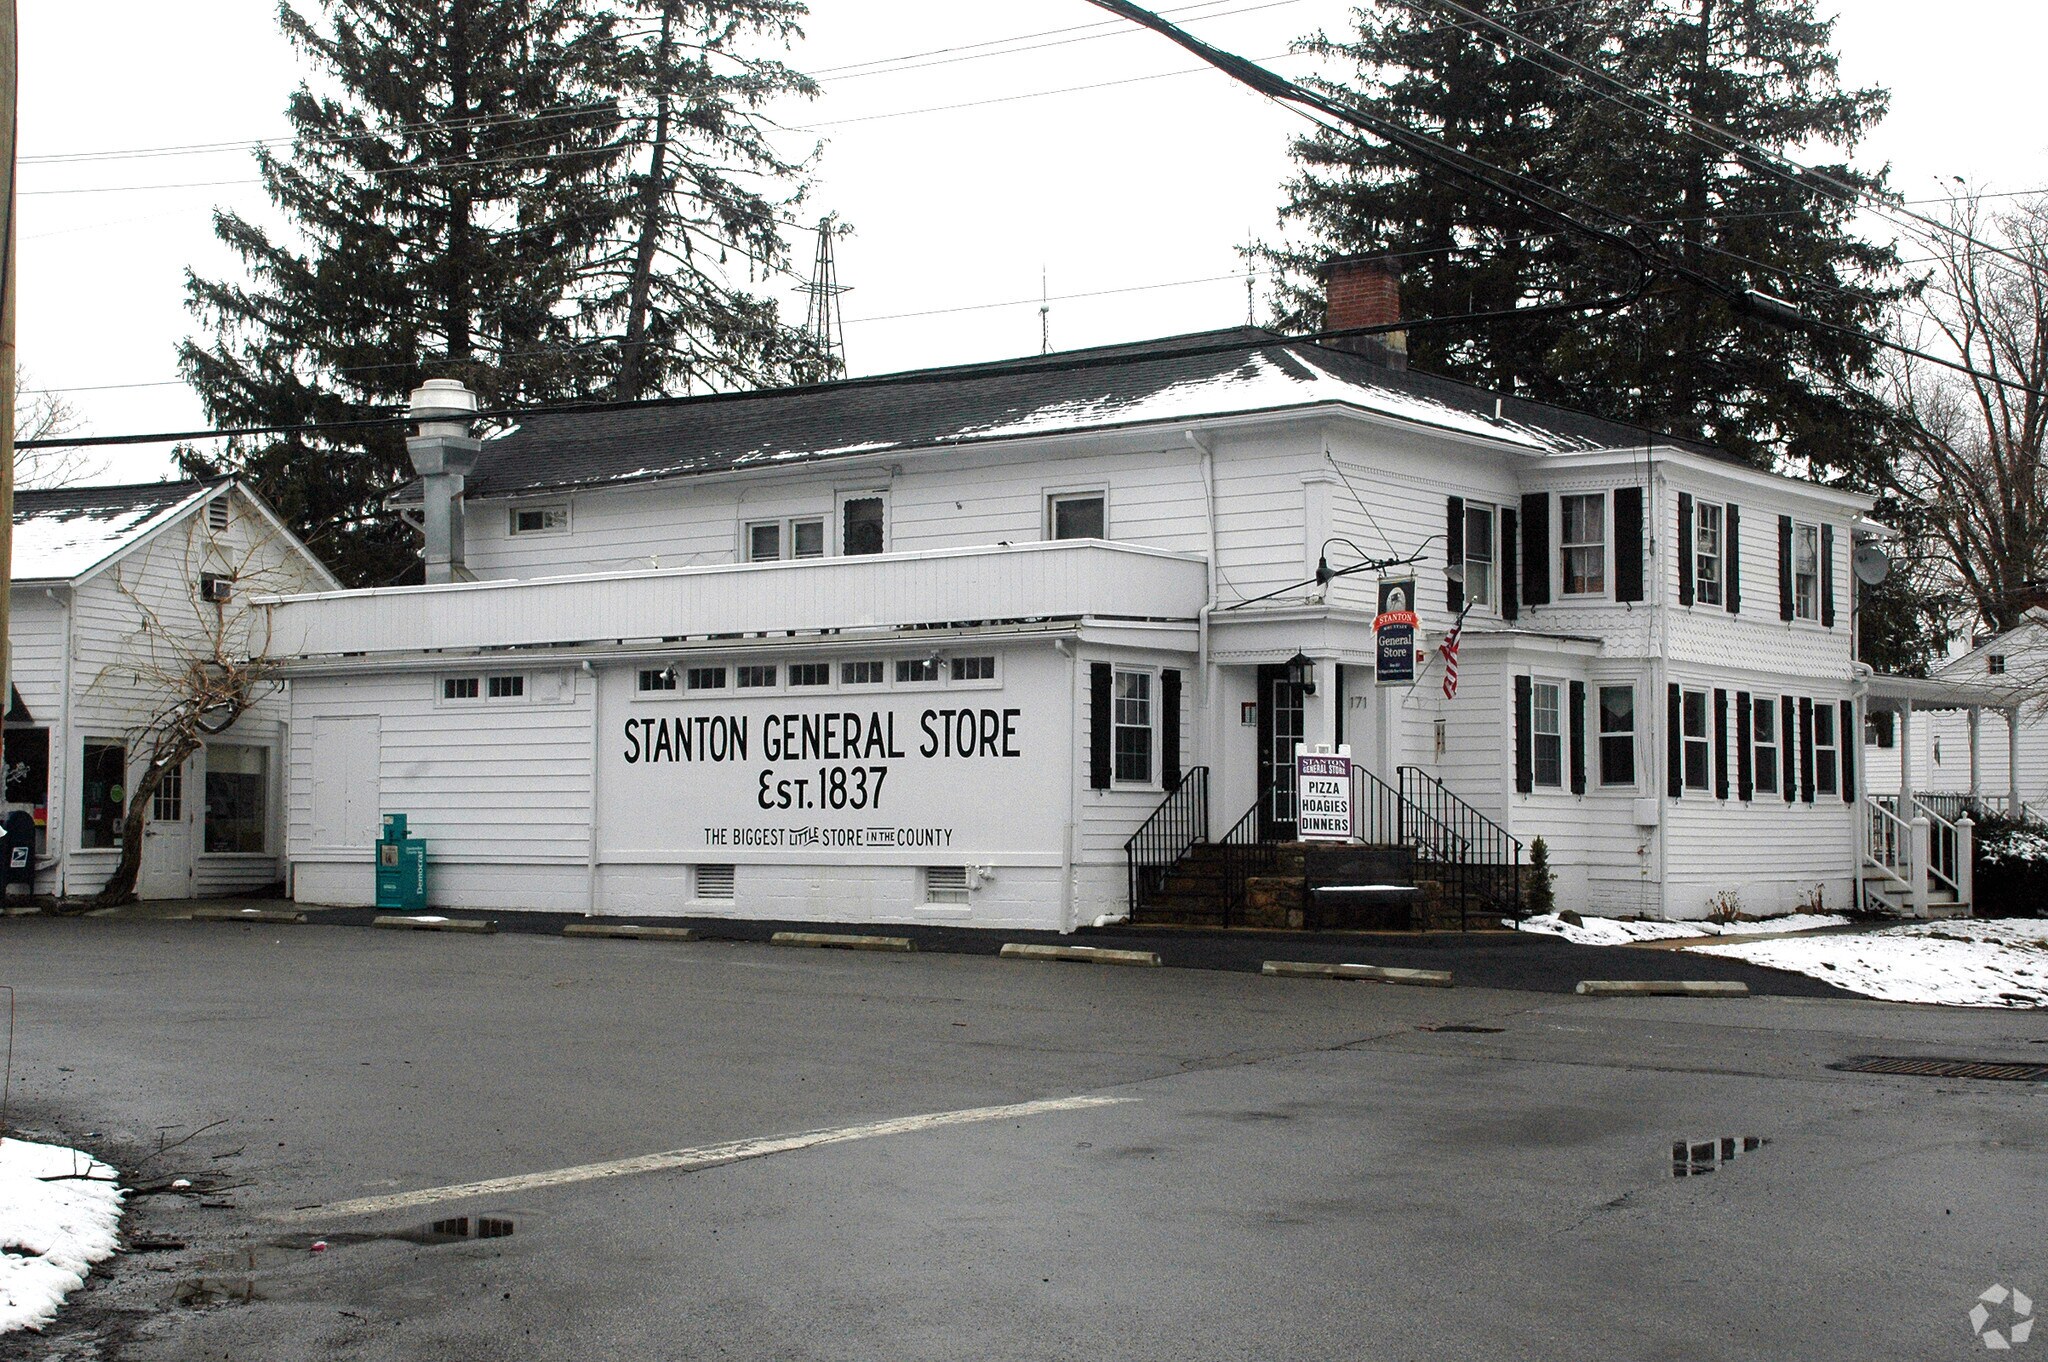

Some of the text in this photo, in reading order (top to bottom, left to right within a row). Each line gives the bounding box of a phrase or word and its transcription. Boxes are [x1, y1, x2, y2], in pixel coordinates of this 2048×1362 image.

[1380, 613, 1412, 624] STANTON
[1379, 634, 1412, 646] General
[1384, 647, 1407, 658] Store
[1350, 696, 1367, 708] 171
[624, 708, 1021, 763] STANTON GENERAL STORE
[1302, 759, 1346, 767] STANTON
[1302, 765, 1346, 775] GENERAL STORE
[1308, 781, 1340, 794] PIZZA
[1302, 799, 1348, 813] HOAGIES
[1302, 817, 1349, 831] DINNERS
[705, 826, 953, 846] THE BIGGEST LITTLE STORE IN THE COUNTY
